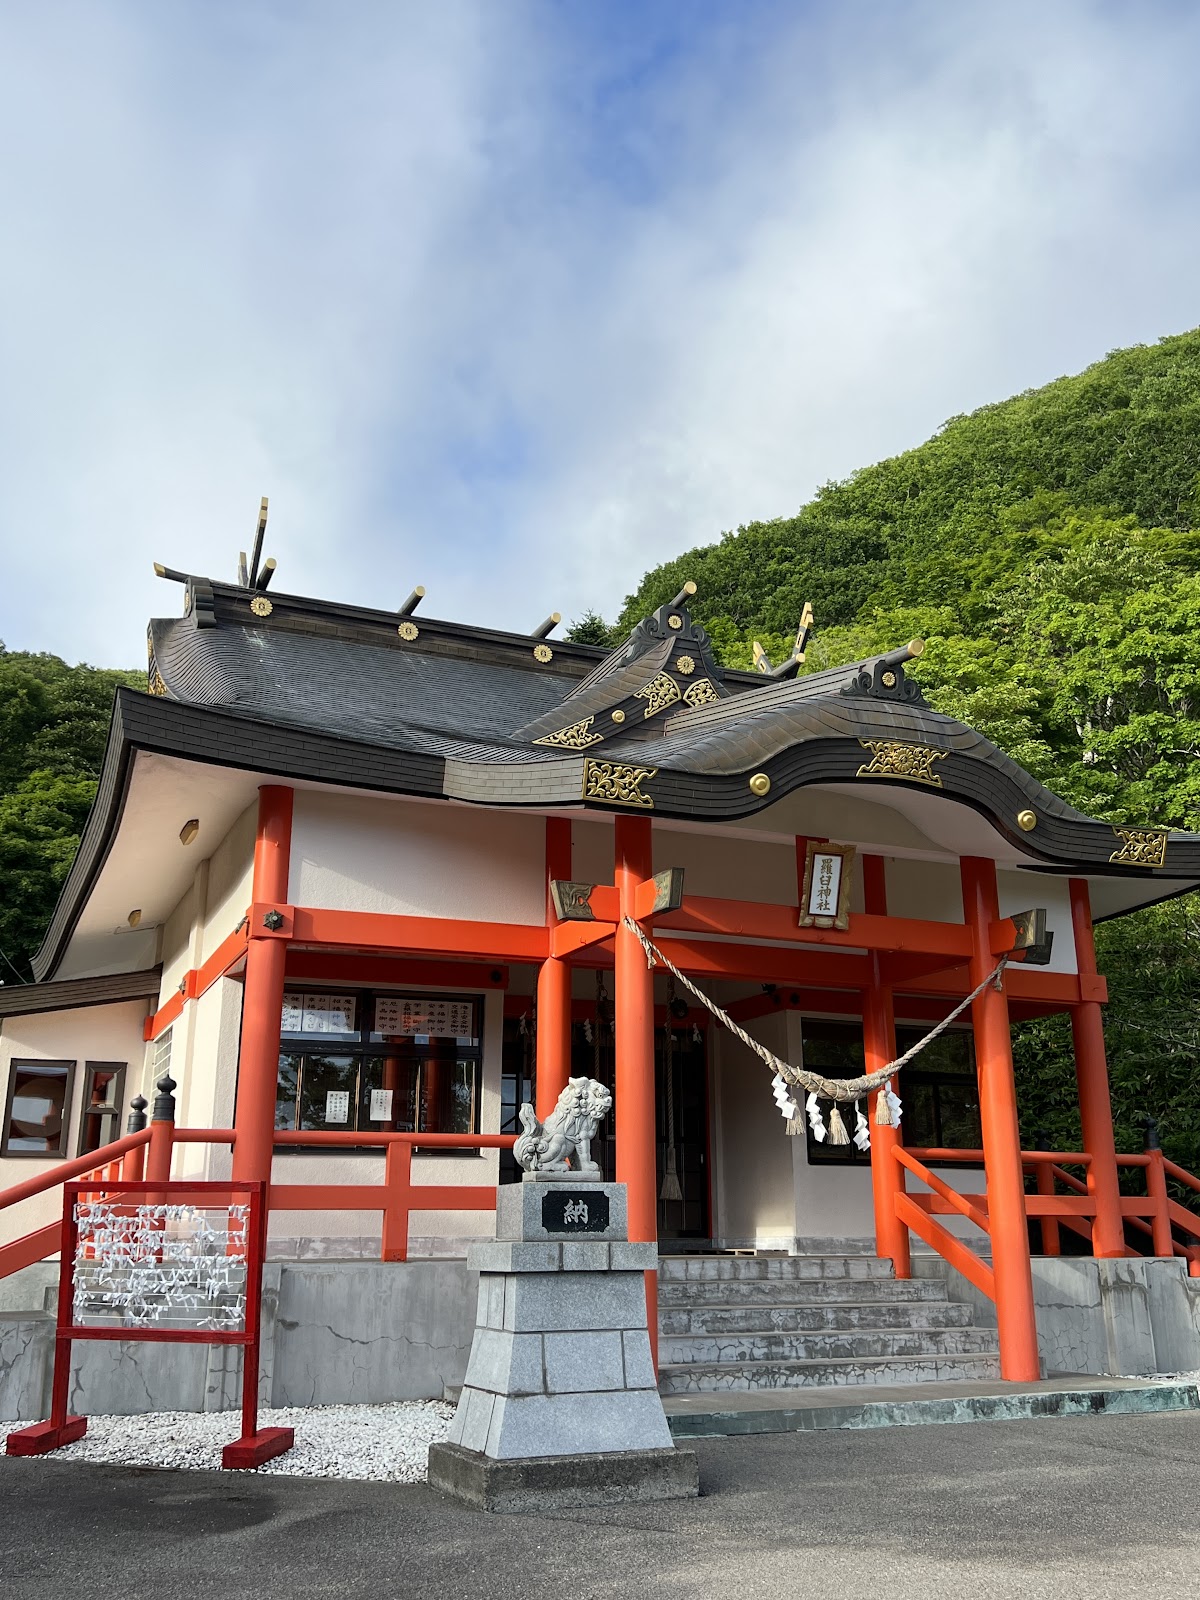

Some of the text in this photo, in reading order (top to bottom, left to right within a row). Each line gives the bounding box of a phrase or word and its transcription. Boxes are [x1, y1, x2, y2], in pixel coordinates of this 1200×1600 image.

[815, 857, 833, 911] 羅臼神社
[450, 1004, 459, 1034] 交通安全御守
[563, 1198, 589, 1225] 納
